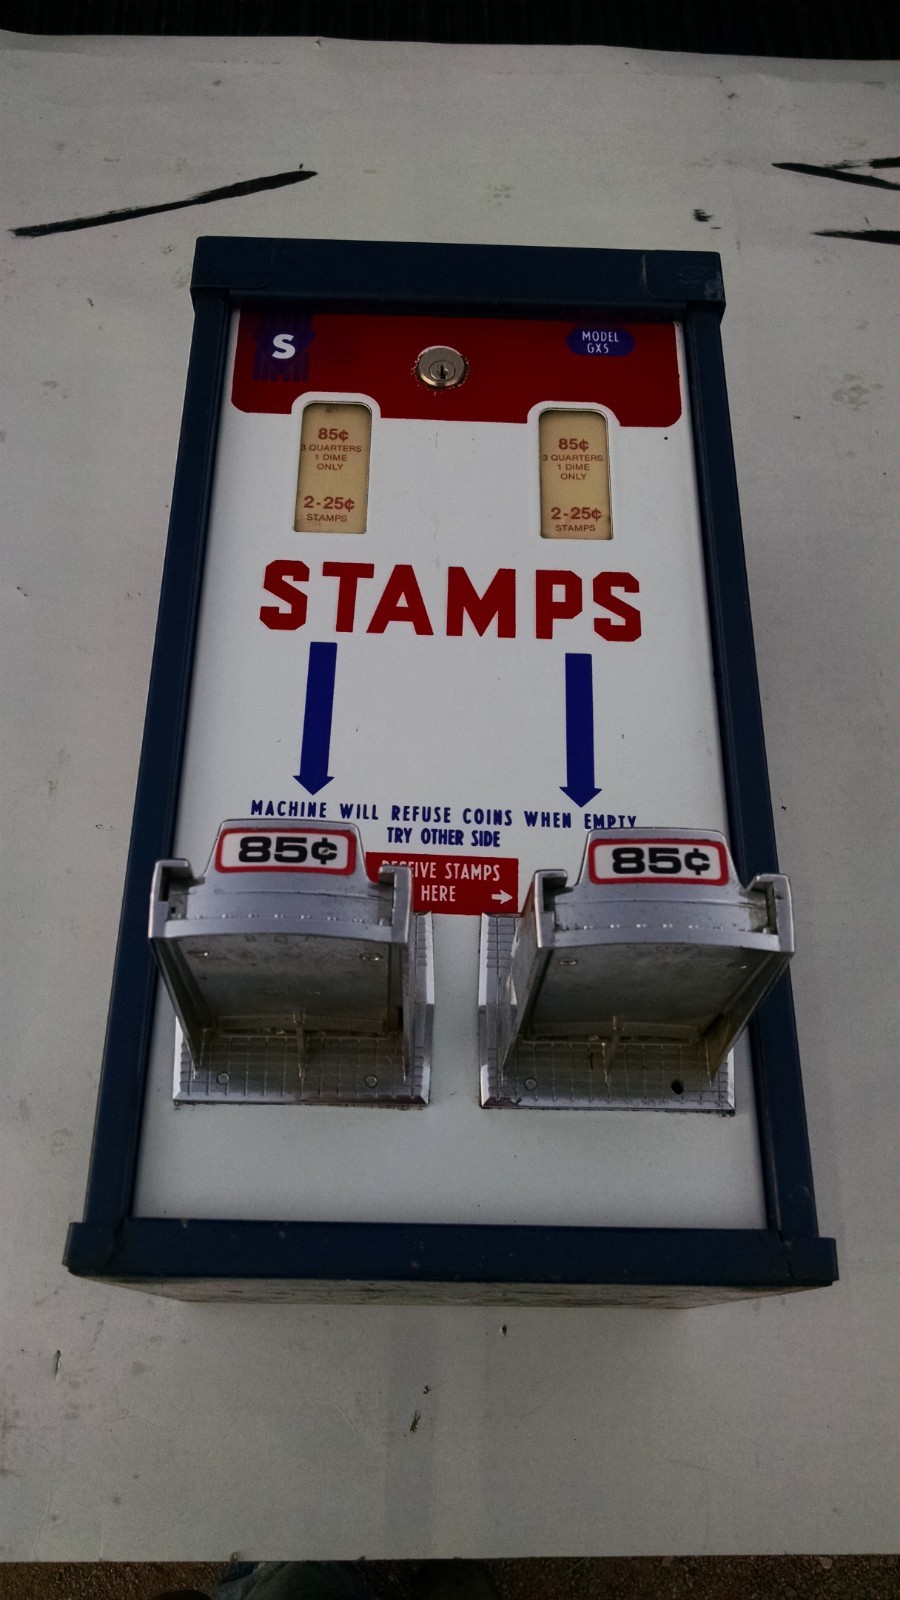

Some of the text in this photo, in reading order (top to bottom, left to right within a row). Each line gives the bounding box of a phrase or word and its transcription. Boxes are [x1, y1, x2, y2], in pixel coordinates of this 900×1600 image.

[582, 330, 619, 343] MODEL
[272, 333, 296, 360] S
[318, 427, 349, 442] 85¢
[309, 444, 362, 453] QUARTERS
[558, 438, 589, 452] 85¢
[323, 453, 347, 462] DIME
[542, 454, 603, 462] 3 QUARTERS
[316, 462, 344, 471] ONLY
[565, 463, 590, 471] DIME
[560, 472, 587, 480] ONLY
[306, 513, 348, 523] STAMPS
[555, 524, 596, 532] STAMPS
[259, 559, 642, 642] STAMPS
[250, 799, 637, 829] MACHINE WILL REFUSE COINS WHEN EMPTY
[387, 827, 501, 847] TRY OTHER SIDE
[238, 836, 338, 865] 85¢
[612, 848, 711, 875] 85¢
[445, 862, 500, 881] STAMPS
[421, 885, 456, 902] HERE
